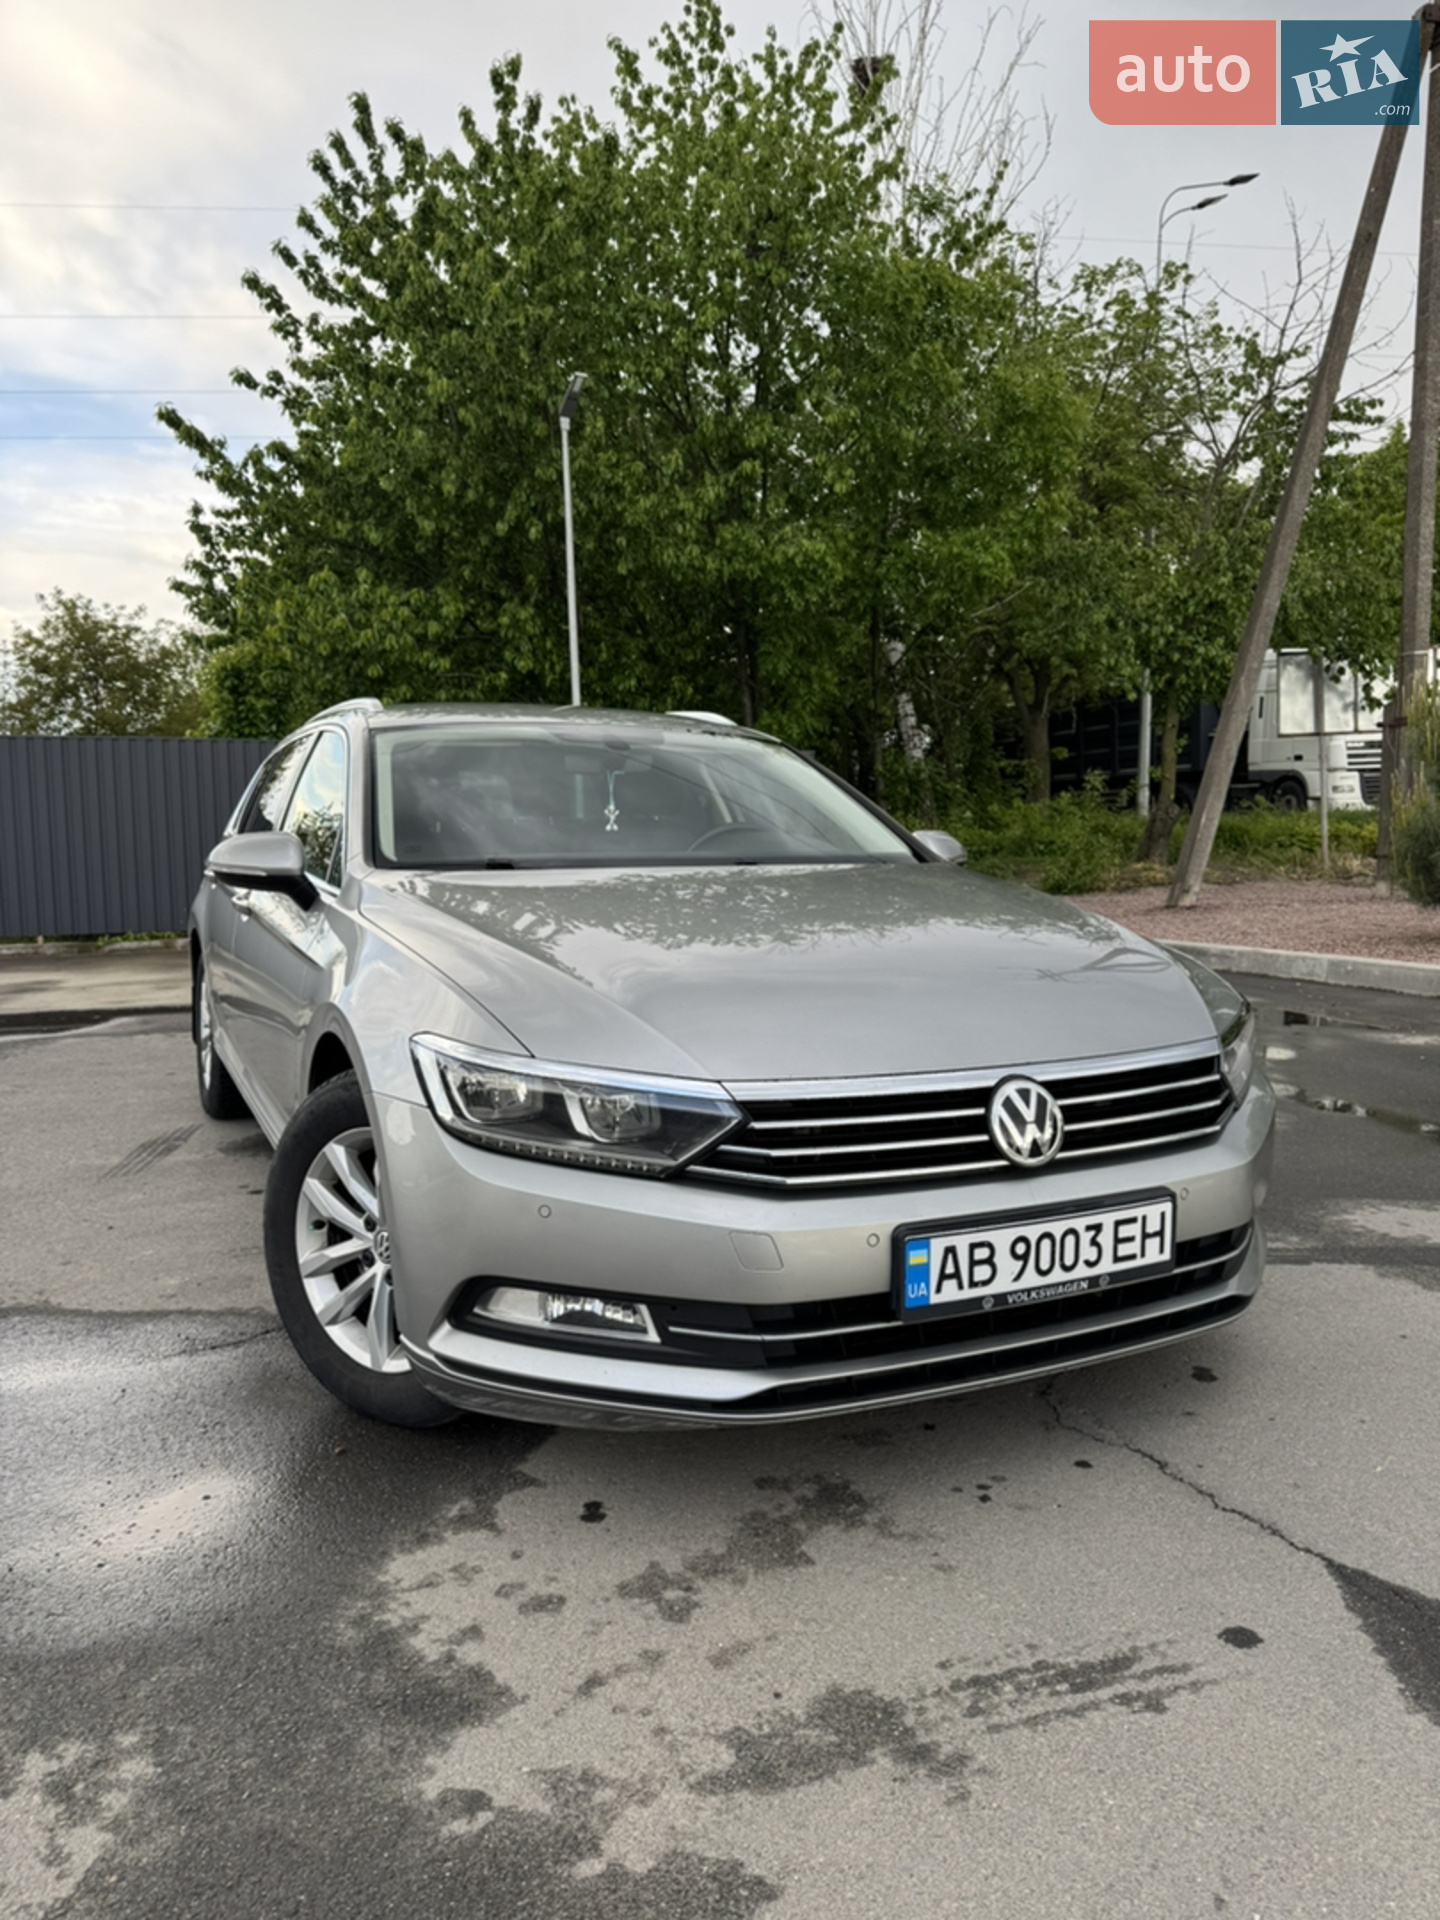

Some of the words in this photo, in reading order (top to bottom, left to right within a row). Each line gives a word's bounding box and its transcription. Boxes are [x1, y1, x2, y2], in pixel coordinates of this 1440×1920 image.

[934, 1240, 998, 1295] AB
[1009, 1222, 1104, 1283] 9003
[1112, 1210, 1167, 1265] EH
[907, 1281, 929, 1299] UA
[1006, 1279, 1090, 1305] VOLKSWAGEN
